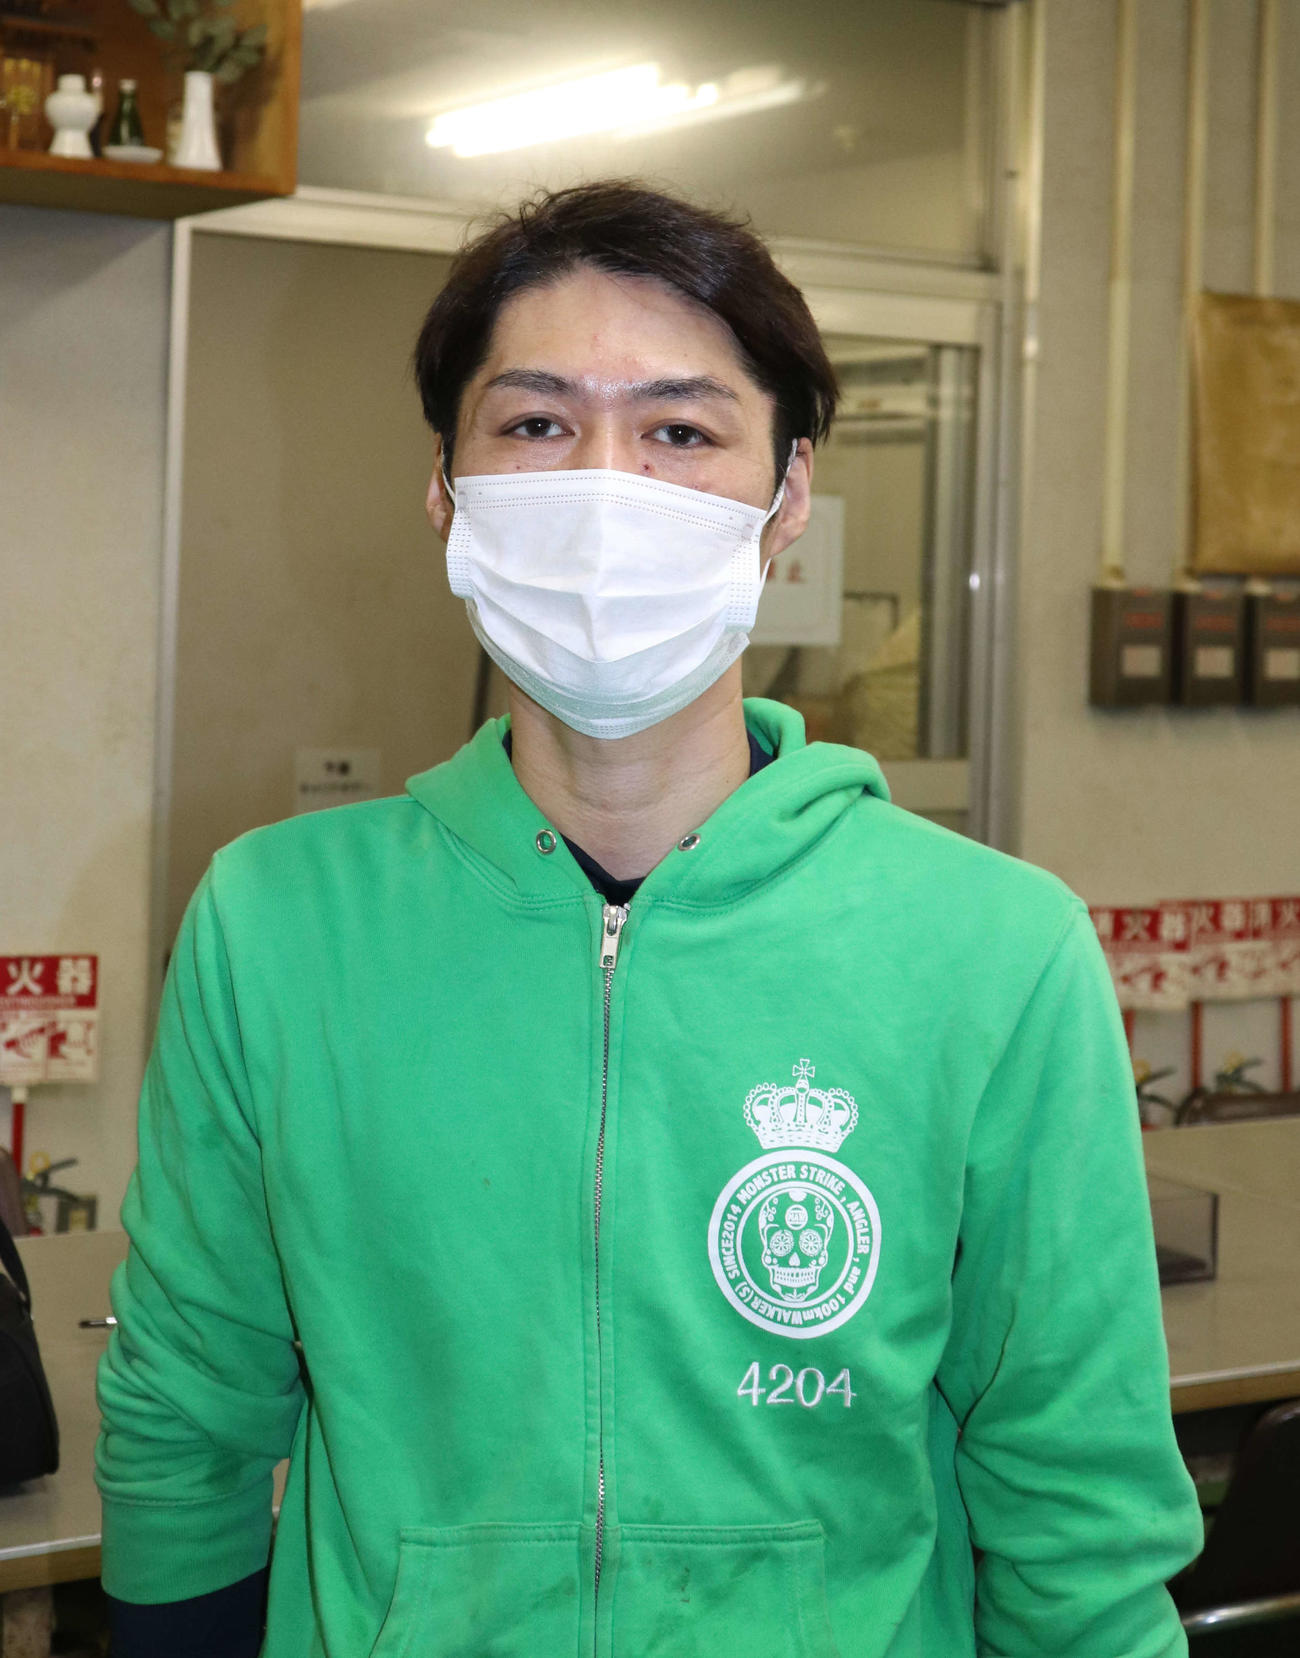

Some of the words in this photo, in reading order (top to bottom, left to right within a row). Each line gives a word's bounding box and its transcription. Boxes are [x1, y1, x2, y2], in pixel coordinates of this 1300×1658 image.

[735, 1164, 797, 1205] MONSTER
[842, 1266, 862, 1296] and
[737, 1361, 857, 1408] 4204
